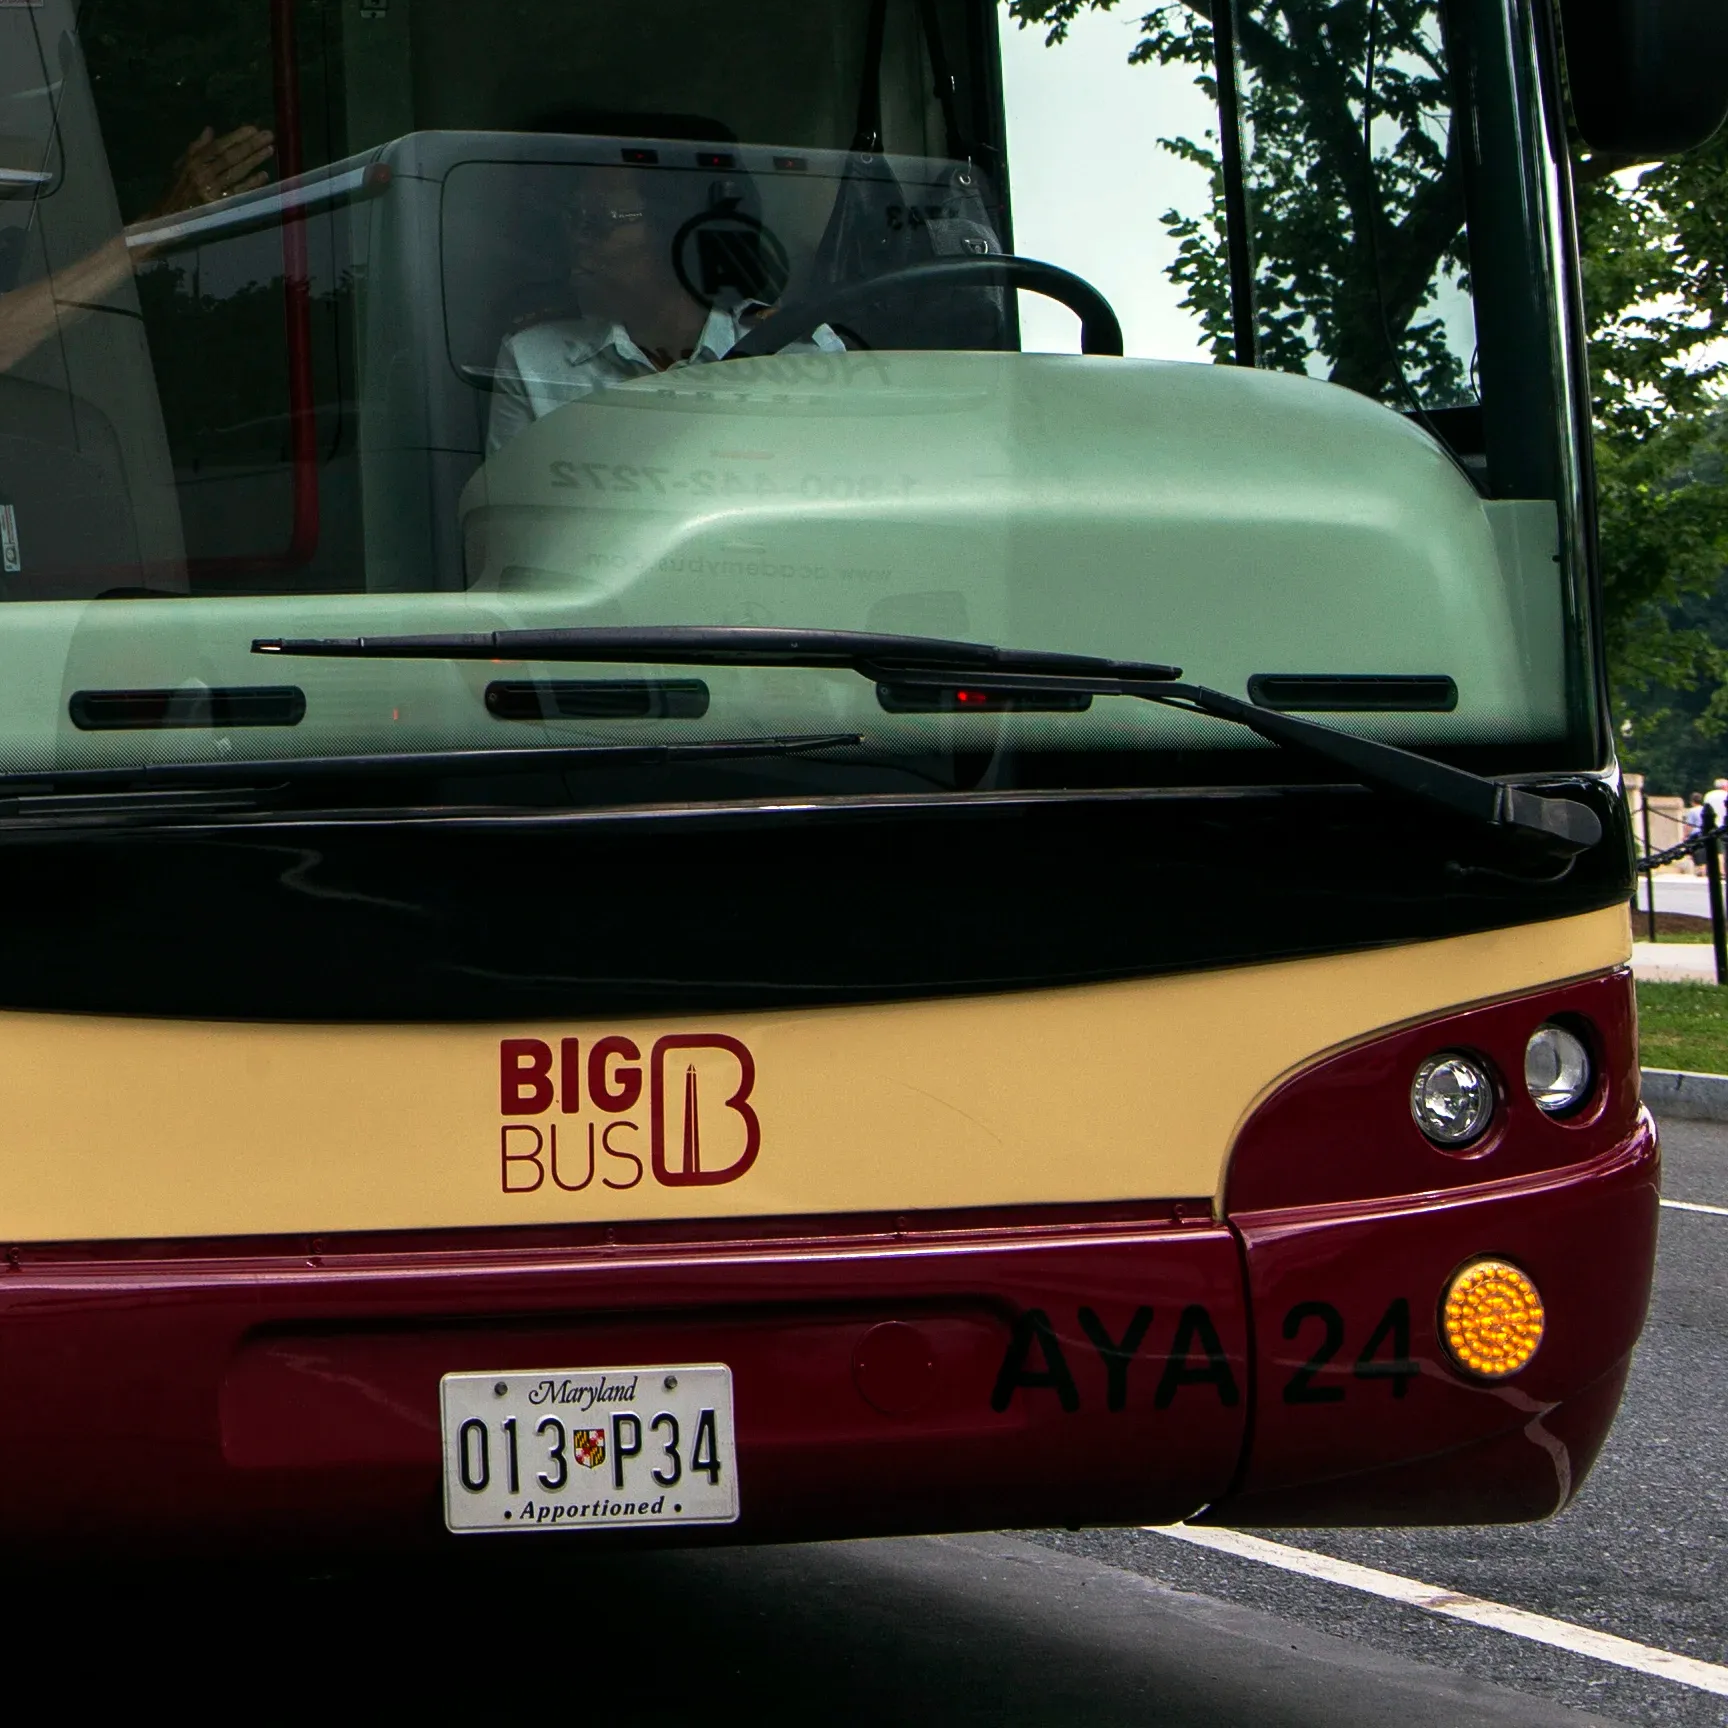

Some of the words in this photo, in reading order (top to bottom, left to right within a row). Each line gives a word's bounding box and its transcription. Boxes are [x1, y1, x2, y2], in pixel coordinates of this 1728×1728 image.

[501, 1035, 642, 1115] BIG
[502, 1118, 644, 1193] BUS
[529, 1376, 638, 1412] Maryland
[990, 1305, 1241, 1412] AYA
[1281, 1300, 1420, 1405] 24
[458, 1414, 570, 1494] 013
[608, 1407, 721, 1490] P34
[519, 1496, 666, 1523] Apportioned
